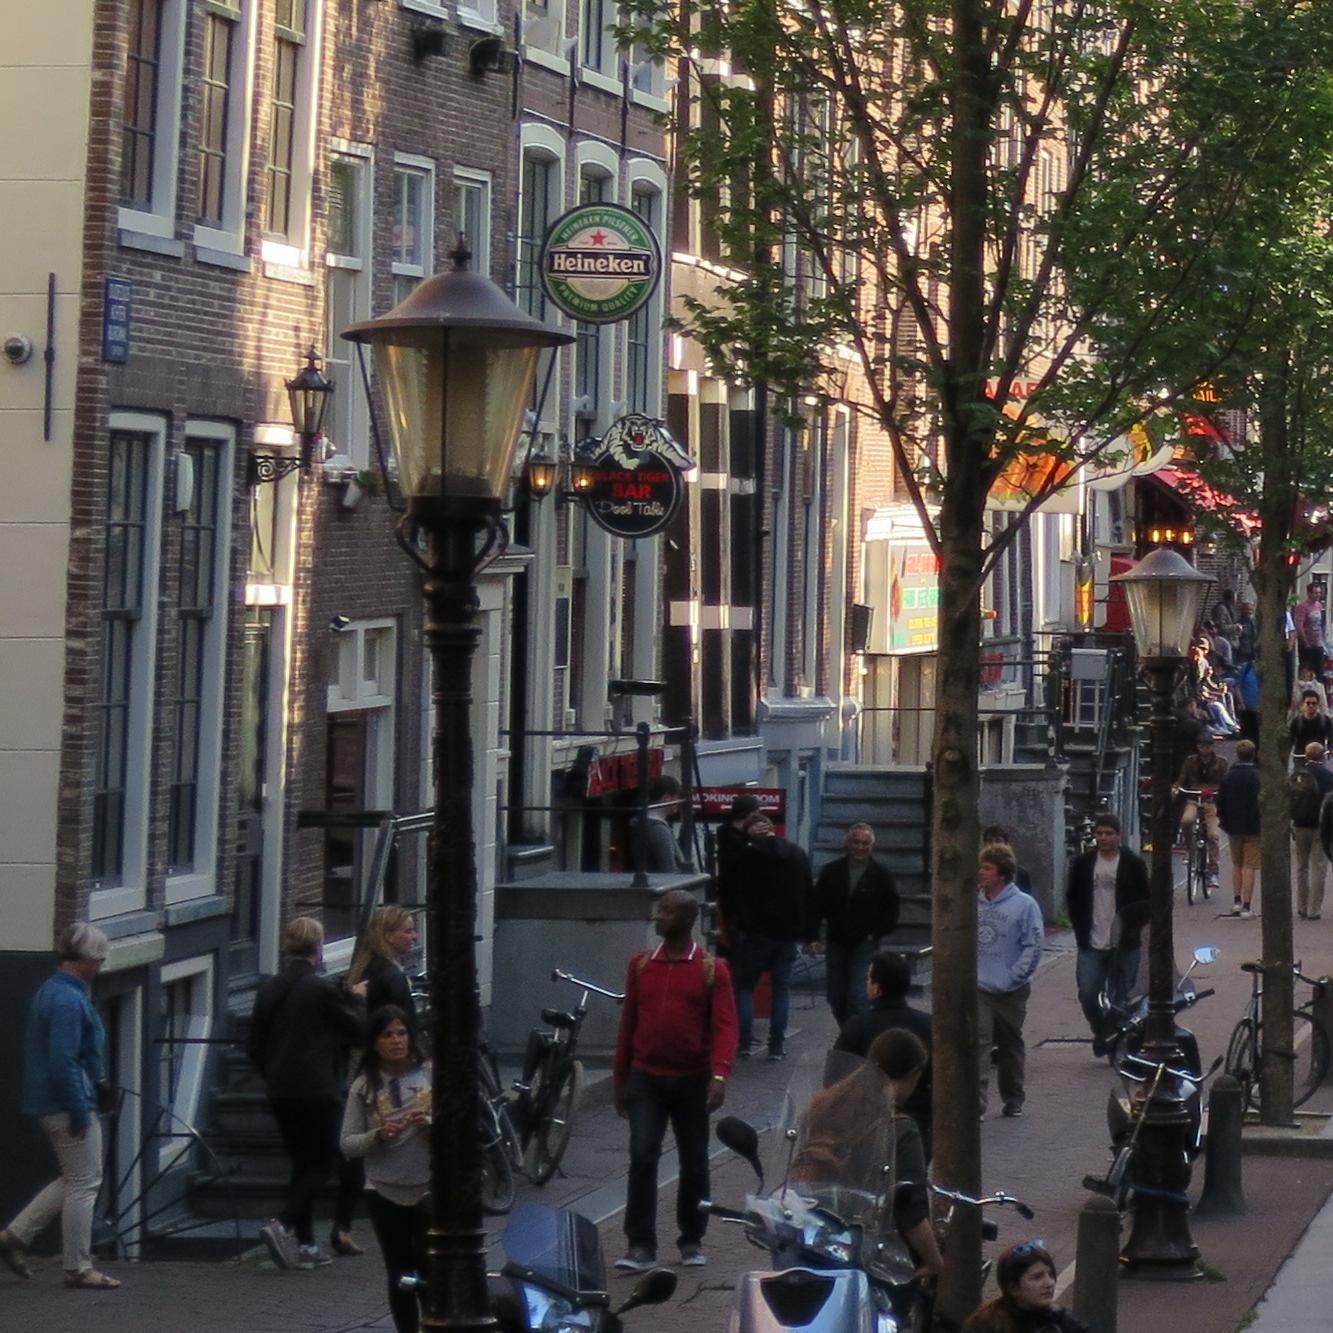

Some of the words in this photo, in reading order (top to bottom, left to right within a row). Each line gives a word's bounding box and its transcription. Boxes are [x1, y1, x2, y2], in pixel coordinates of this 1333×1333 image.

[553, 253, 645, 273] Heineken
[558, 284, 598, 311] PREMIUM
[601, 285, 638, 311] QUALITY
[613, 483, 652, 498] BAR
[596, 501, 632, 515] Pool
[691, 793, 739, 802] MOKING
